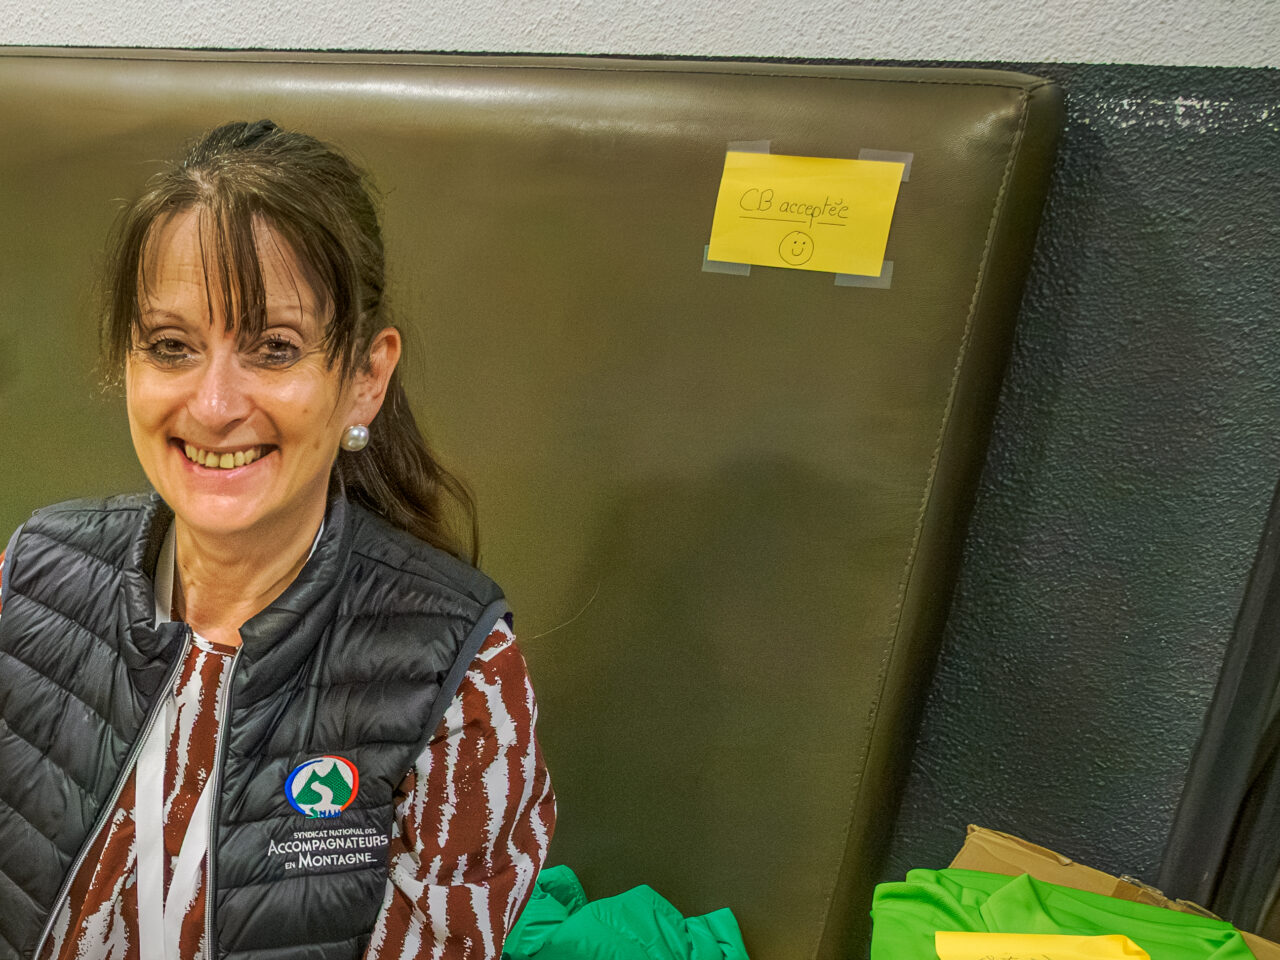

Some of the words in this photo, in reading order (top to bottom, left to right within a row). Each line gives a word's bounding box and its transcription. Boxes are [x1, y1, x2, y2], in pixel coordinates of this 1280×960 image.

[739, 188, 774, 212] CB
[293, 830, 328, 839] SYNDICAT
[329, 828, 364, 837] NATIONAL
[267, 834, 389, 857] ACCOMPAGNATEURS
[285, 861, 296, 870] EN
[298, 851, 374, 869] MONTAGNE
